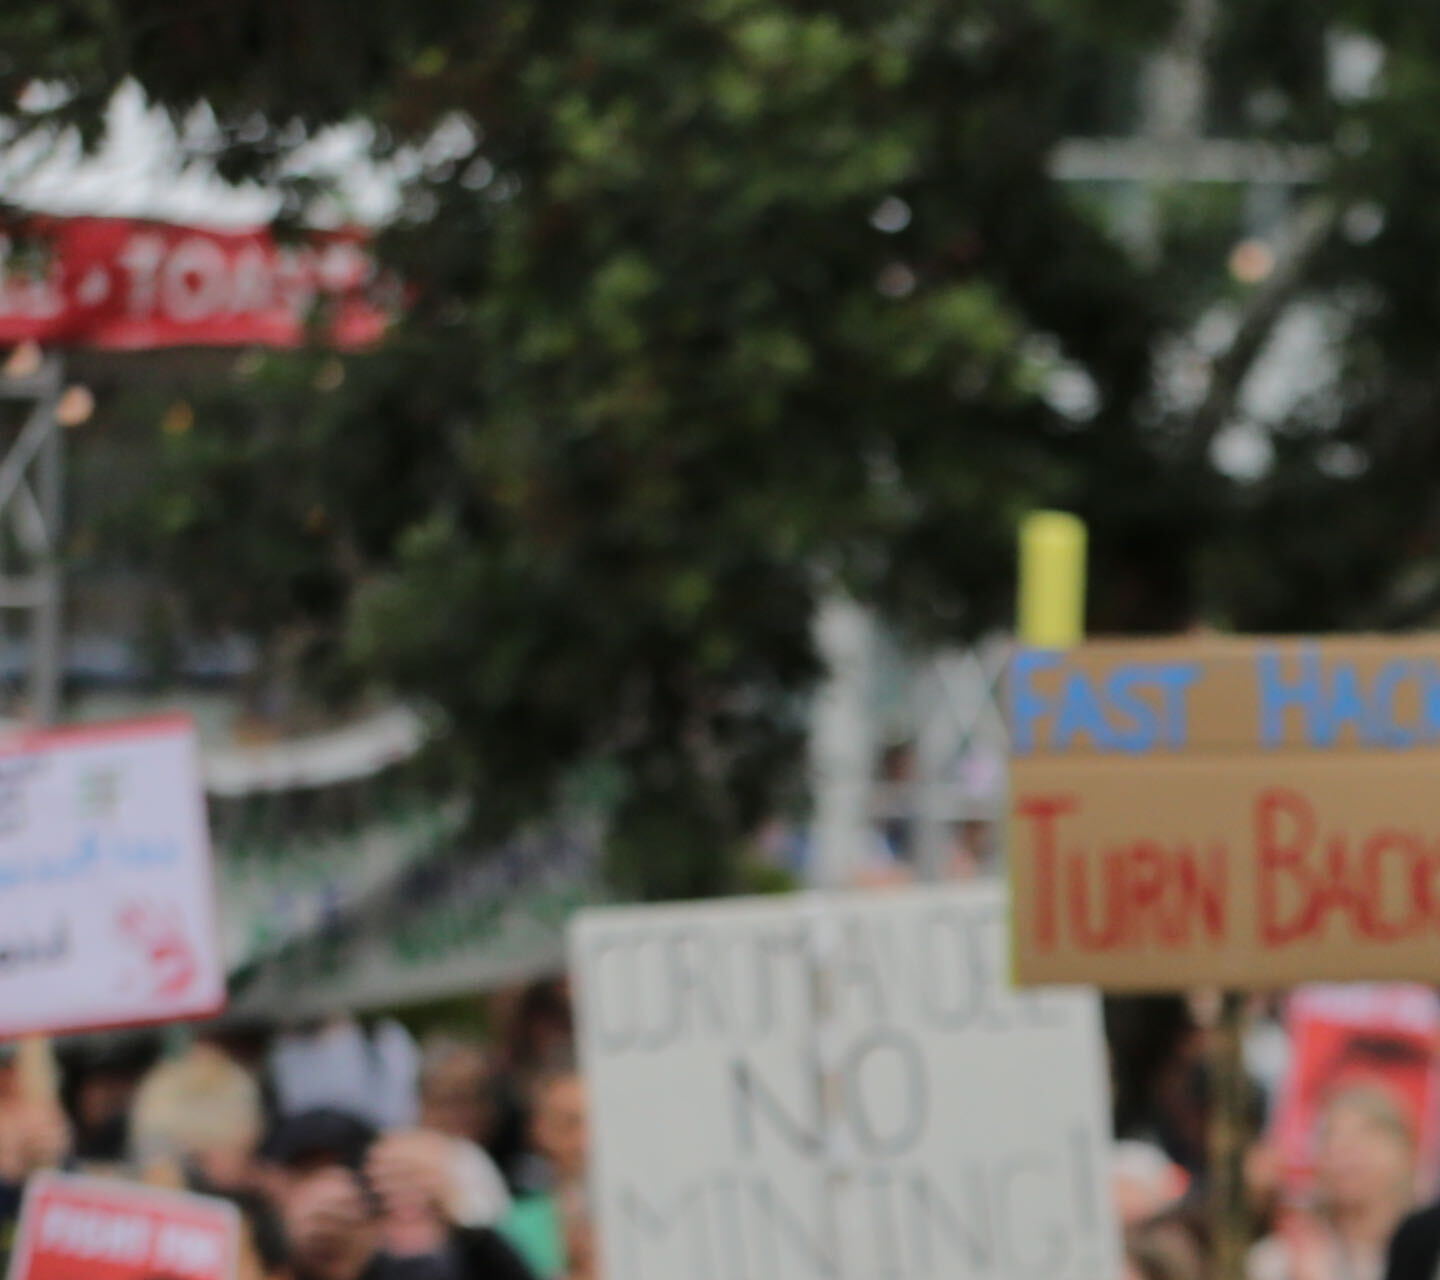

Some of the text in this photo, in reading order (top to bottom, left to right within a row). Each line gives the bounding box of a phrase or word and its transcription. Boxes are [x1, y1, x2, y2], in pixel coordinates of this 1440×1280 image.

[1009, 647, 1206, 758] FAST
[1014, 791, 1228, 955] TURN
[726, 1022, 931, 1160] NO
